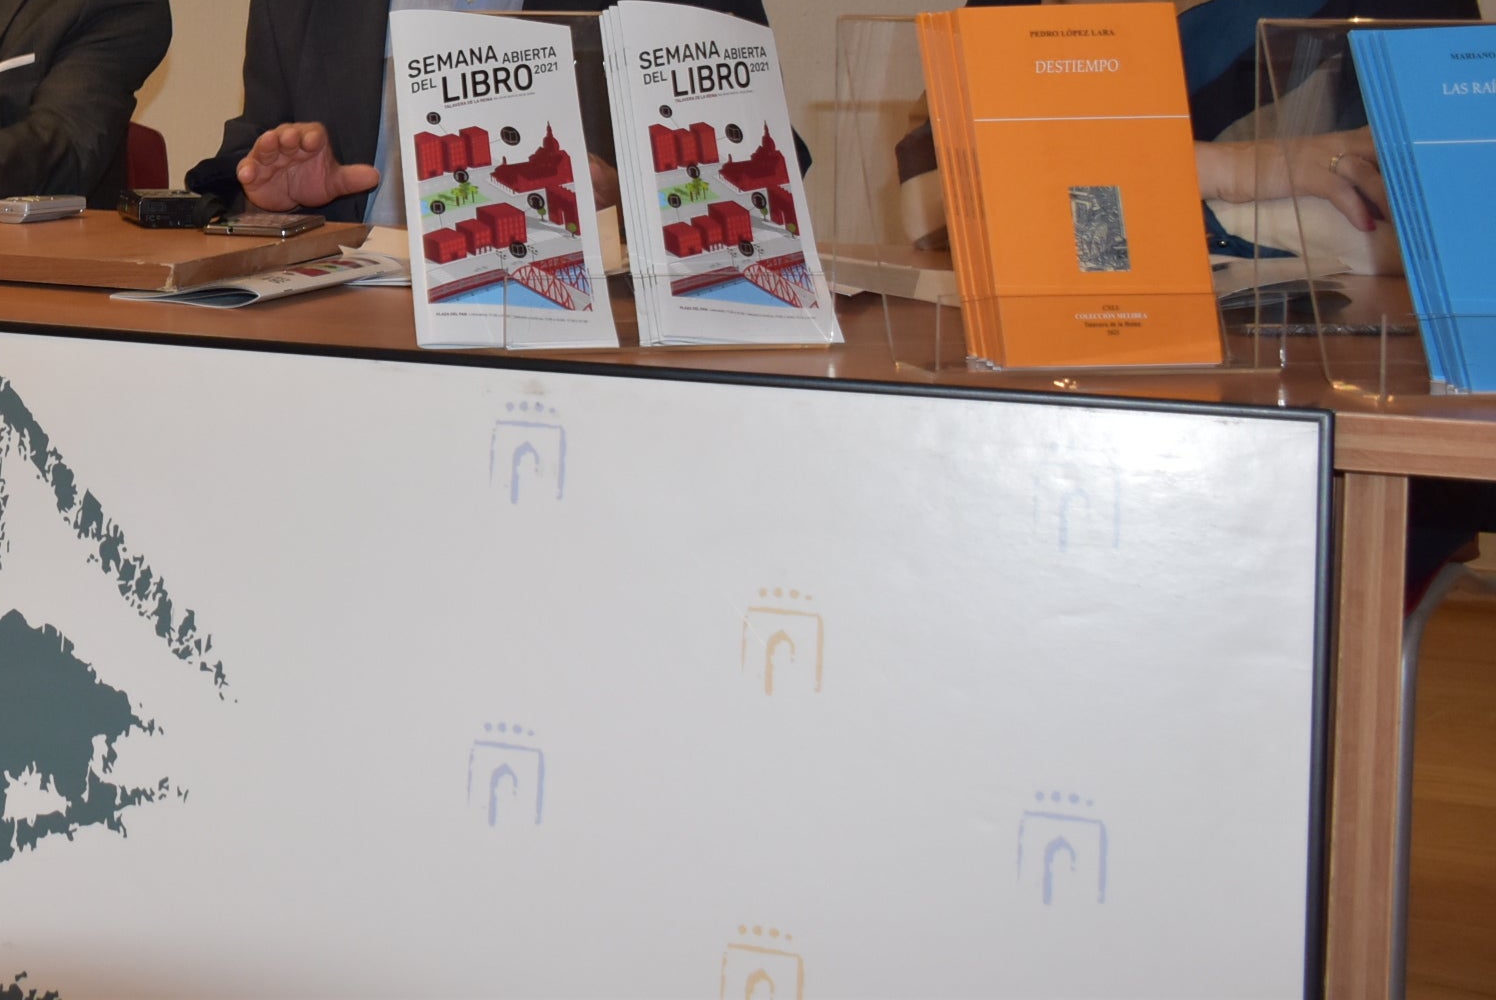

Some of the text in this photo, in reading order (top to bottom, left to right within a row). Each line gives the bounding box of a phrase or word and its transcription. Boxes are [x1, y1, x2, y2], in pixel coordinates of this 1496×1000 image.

[1030, 30, 1058, 38] PEDRO
[1061, 28, 1089, 37] LÓPEZ
[408, 45, 557, 79] SEMANA ABIERTA
[639, 40, 767, 70] SEMANA ABIERTA
[1450, 52, 1496, 60] MARIANO
[1035, 59, 1119, 74] DESTIEMPO
[411, 78, 437, 94] DEL
[442, 63, 533, 103] LIBRO
[533, 62, 559, 74] 2021
[643, 70, 668, 85] DEL
[671, 61, 751, 98] LIBRO
[750, 62, 770, 73] 2021
[1442, 82, 1468, 95] LAS
